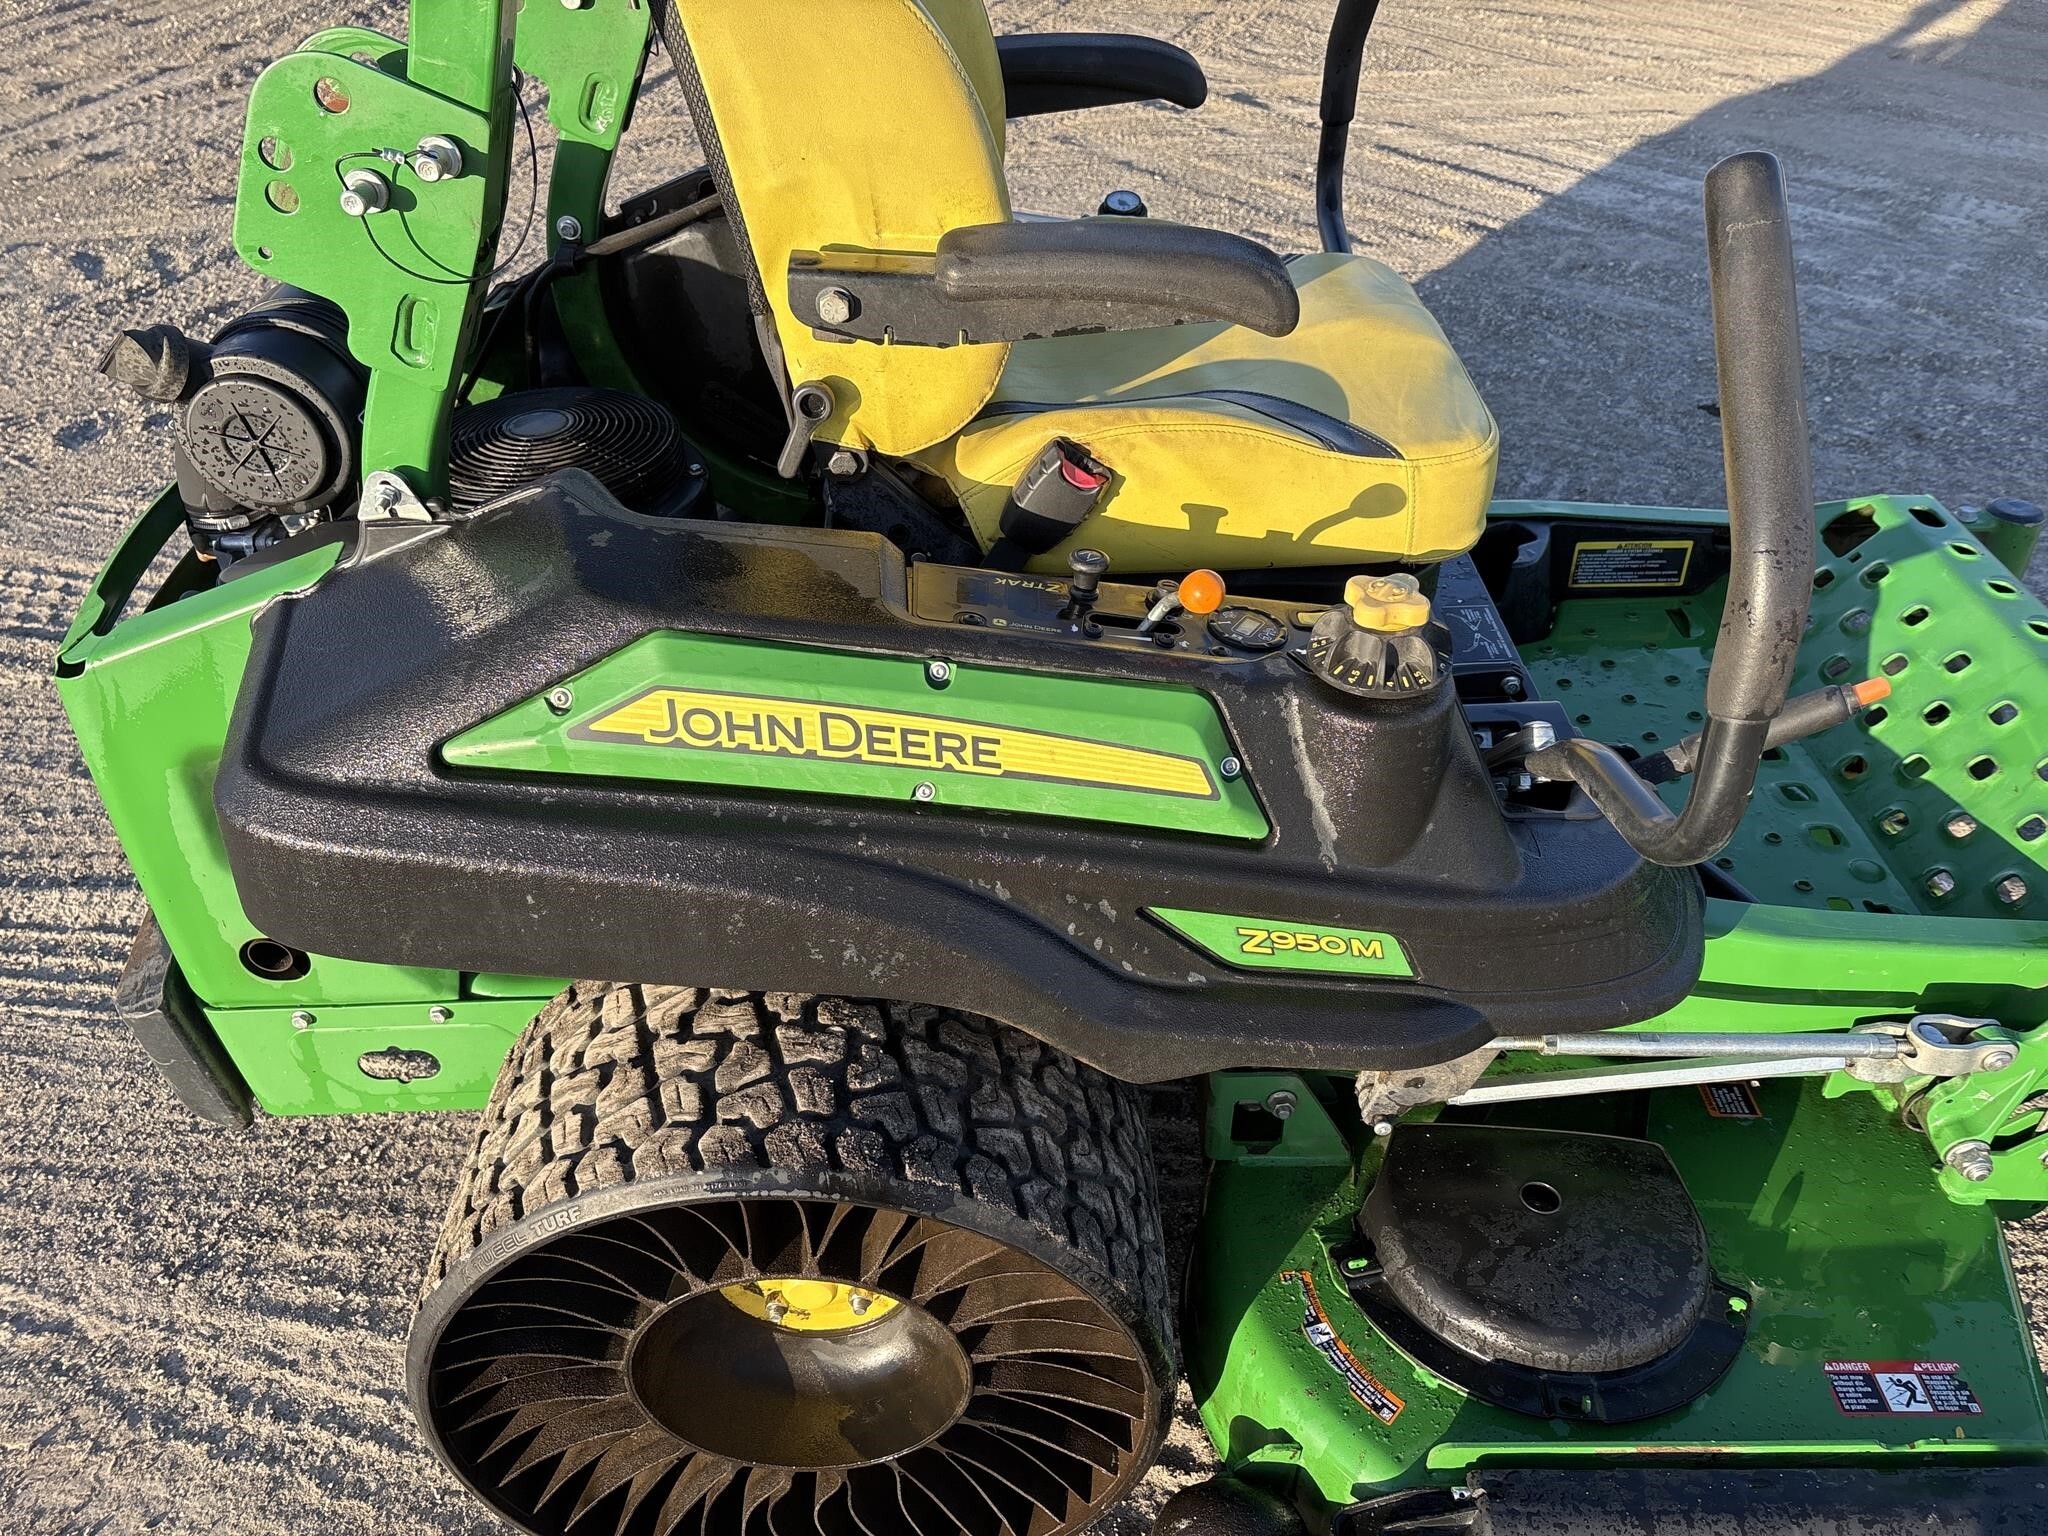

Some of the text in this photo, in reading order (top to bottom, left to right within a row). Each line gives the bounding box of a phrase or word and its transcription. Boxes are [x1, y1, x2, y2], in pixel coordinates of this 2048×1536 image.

[1010, 622, 1063, 634] JOHN DEERE
[1312, 640, 1327, 648] 5.5
[1347, 669, 1361, 684] 4.5
[1413, 671, 1427, 687] 3.5
[649, 698, 1004, 770] JOHN DEERE
[1236, 926, 1385, 960] Z950M
[471, 1232, 529, 1272] TWEEL
[531, 1206, 582, 1237] TURF
[1831, 1362, 1871, 1371] DANGER
